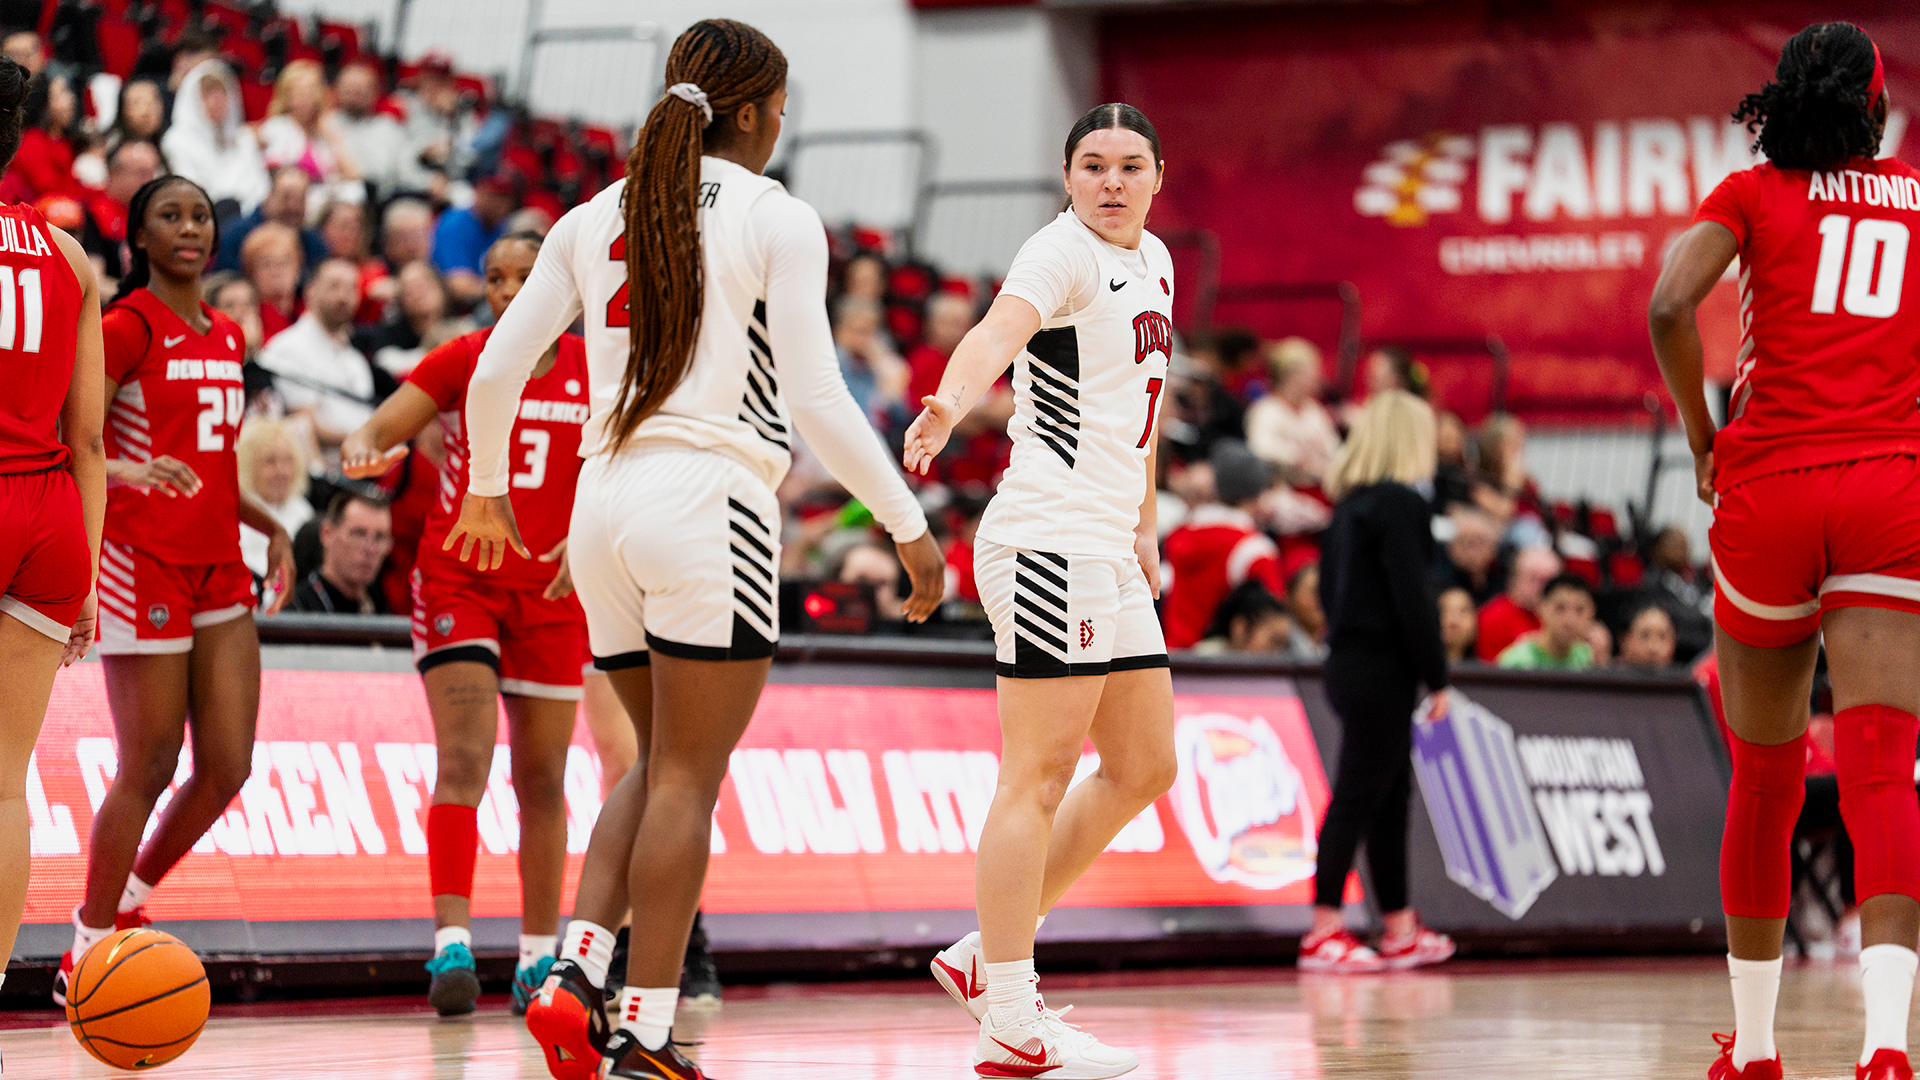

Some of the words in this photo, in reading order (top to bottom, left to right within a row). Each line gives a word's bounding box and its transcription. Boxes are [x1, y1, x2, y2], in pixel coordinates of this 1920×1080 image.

[1807, 169, 1920, 211] ANTONIO
[1810, 213, 1910, 319] 10
[166, 359, 204, 380] NEW
[197, 386, 245, 452] 24
[512, 428, 551, 489] 3
[1517, 735, 1645, 787] MOUNTAIN
[1534, 788, 1666, 877] WEST
